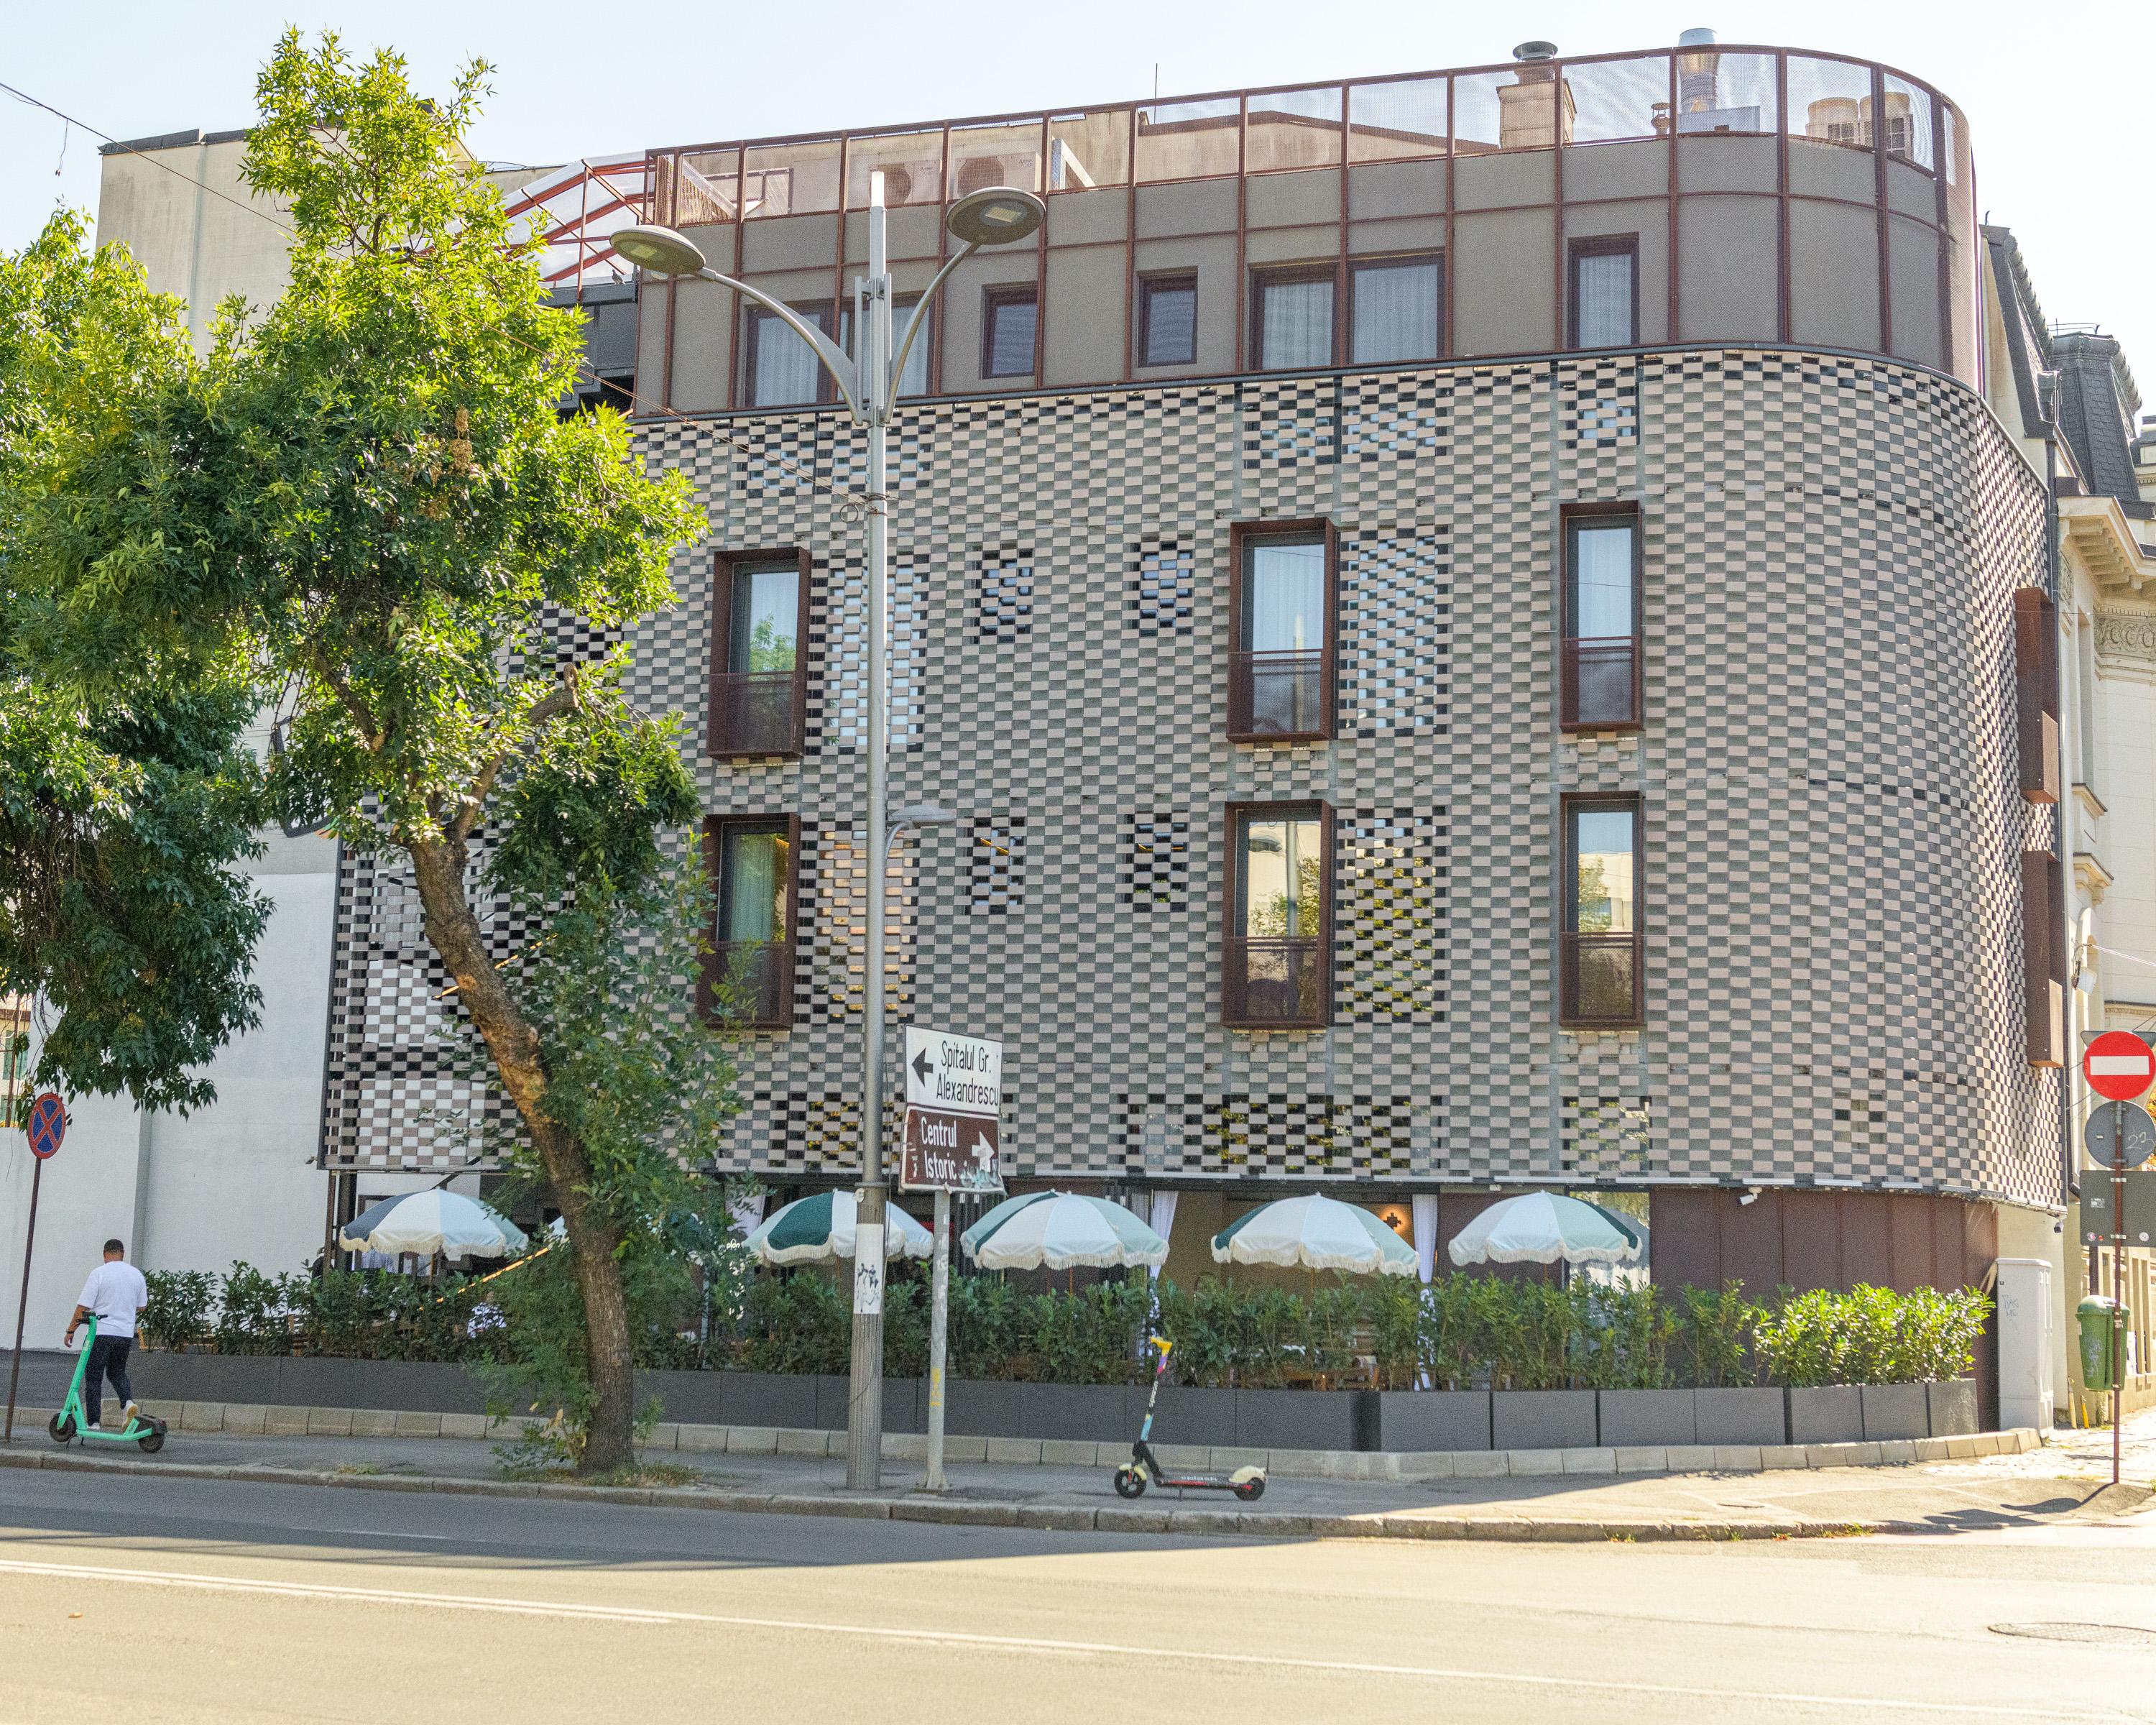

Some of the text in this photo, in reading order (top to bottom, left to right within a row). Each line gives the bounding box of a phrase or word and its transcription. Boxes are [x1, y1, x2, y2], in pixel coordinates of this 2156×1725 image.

[941, 1040, 991, 1075] Spitalul Gr.
[936, 1073, 1000, 1106] Alexandrescu
[921, 1116, 957, 1148] Centrul
[923, 1149, 957, 1180] Istoric
